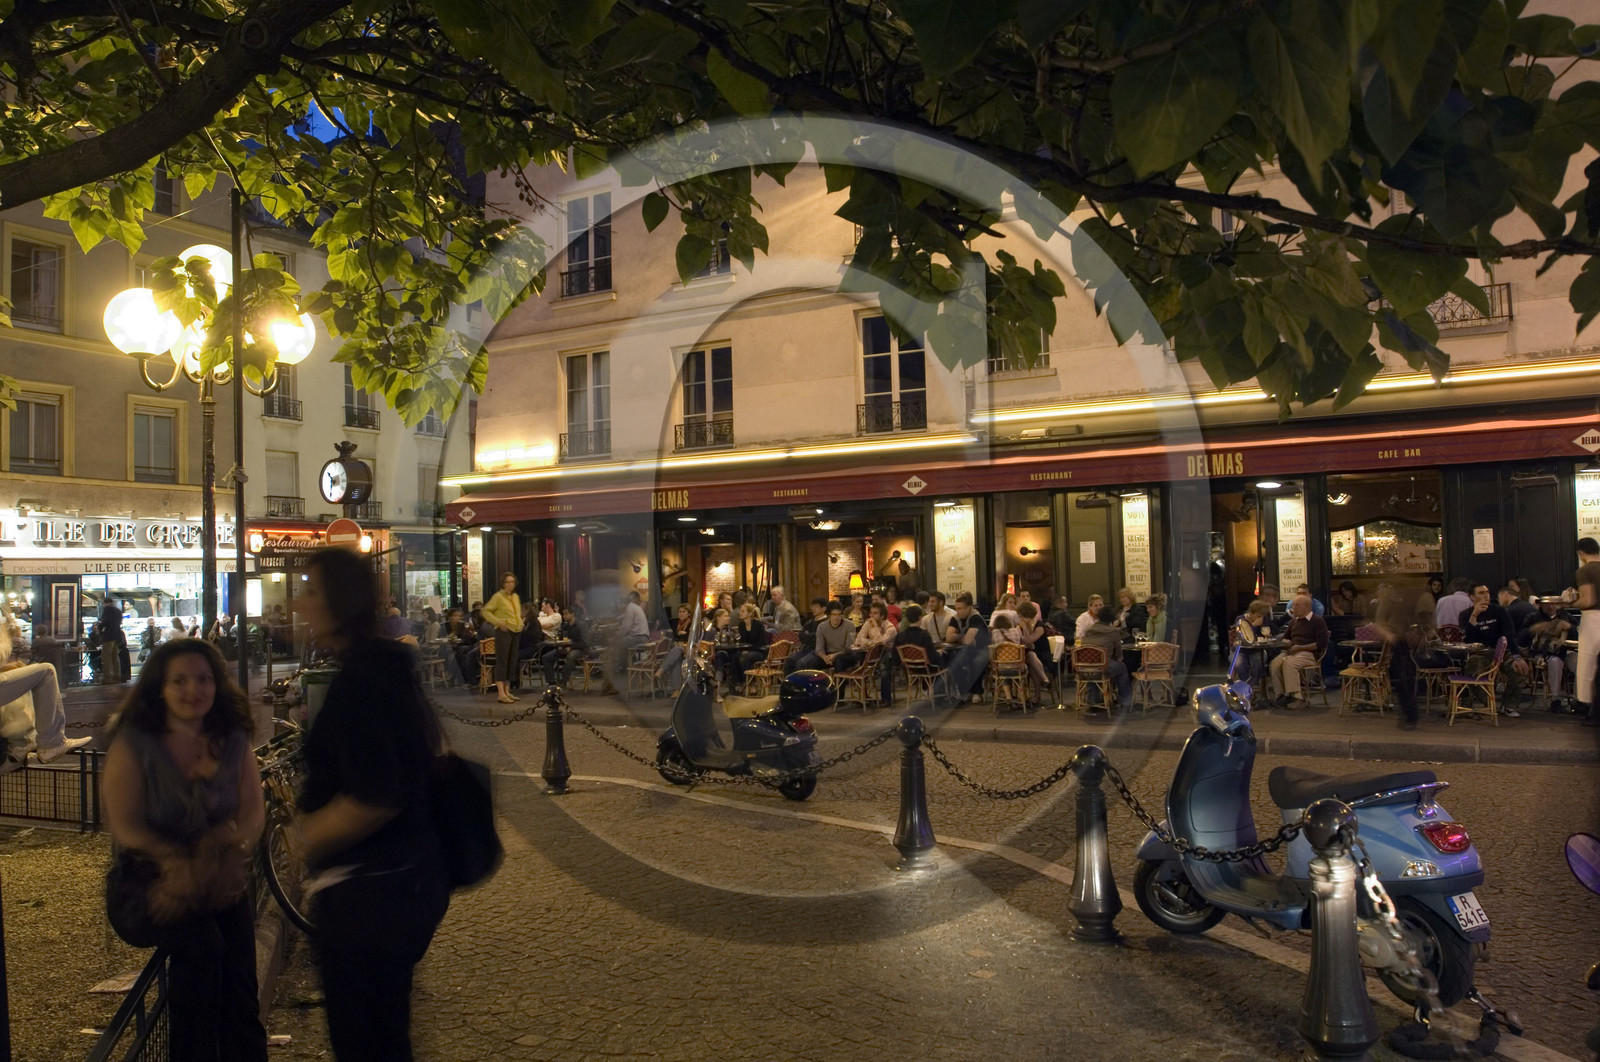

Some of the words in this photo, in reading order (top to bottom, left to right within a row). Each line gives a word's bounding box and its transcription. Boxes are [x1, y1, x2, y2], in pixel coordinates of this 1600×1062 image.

[1581, 436, 1600, 445] DELMA
[1378, 450, 1398, 459] CAFE
[1404, 448, 1421, 457] BAR
[1187, 452, 1244, 477] DELMAS
[1030, 471, 1073, 481] RESTAURANT
[773, 488, 808, 497] RESTAURANT
[651, 490, 689, 510] DELMAS
[1281, 519, 1302, 528] SODAS
[99, 522, 136, 543] DE
[145, 524, 236, 550] CREE
[84, 563, 113, 573] L'ILE
[117, 563, 131, 573] DE
[134, 563, 171, 573] CRETE
[1457, 908, 1488, 928] 541E
